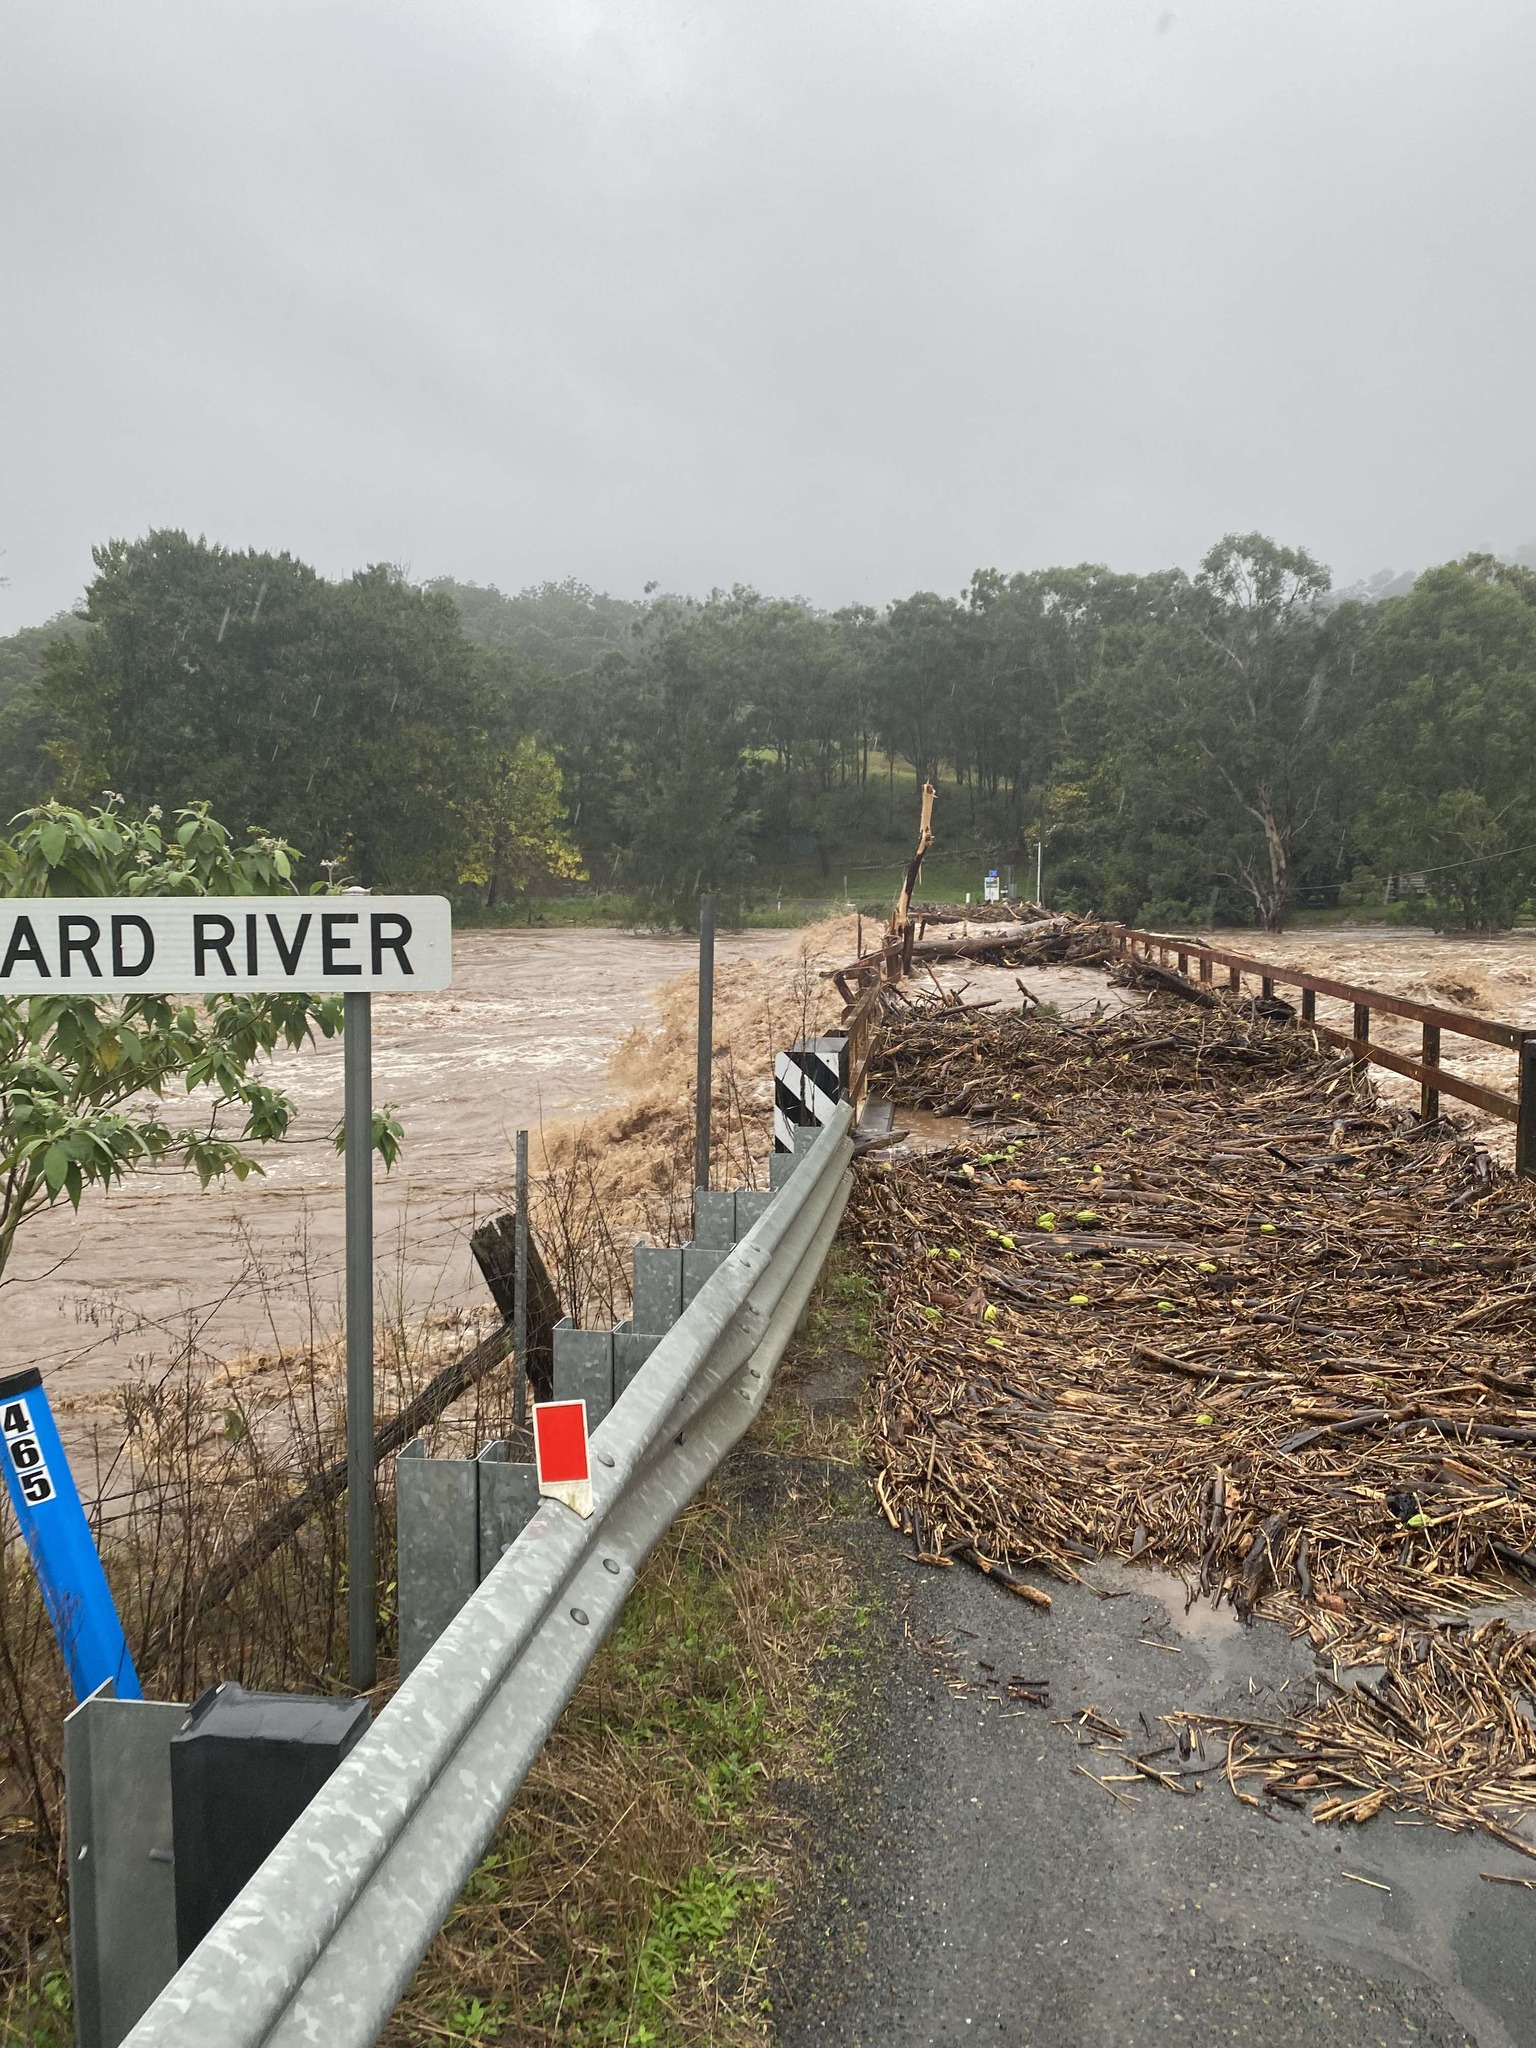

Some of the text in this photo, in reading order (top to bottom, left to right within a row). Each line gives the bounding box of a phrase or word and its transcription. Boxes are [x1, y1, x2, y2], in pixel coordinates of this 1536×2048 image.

[0, 913, 415, 978] ARD RIVER
[3, 1403, 52, 1502] 465
